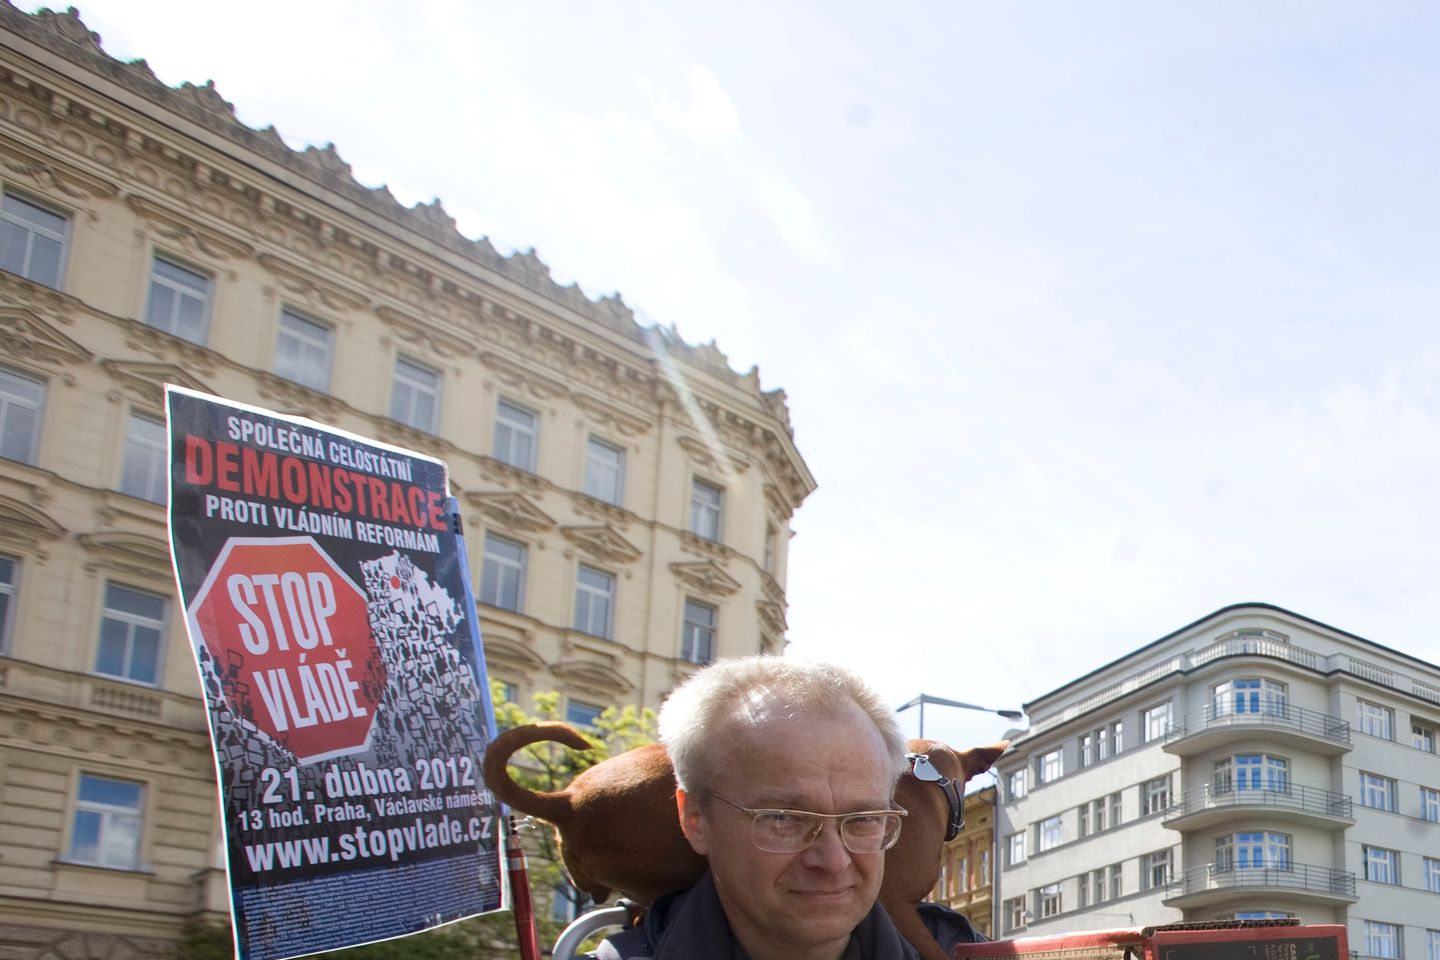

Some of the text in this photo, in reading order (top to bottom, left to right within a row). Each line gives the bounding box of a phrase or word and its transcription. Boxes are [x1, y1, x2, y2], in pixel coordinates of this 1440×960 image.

[227, 416, 412, 482] SPOLEČNÁ CELOSTÁTNÍ
[185, 435, 448, 531] DEMONSTRACE
[206, 494, 440, 554] PROTI VLÁDNÍM REFORMÁM
[227, 571, 337, 655] STOP
[252, 648, 368, 732] VLÁDĚ
[261, 756, 475, 804] 21. dubna 2012
[238, 810, 263, 831] 13
[269, 805, 310, 827] hod.
[315, 801, 371, 825] Praha,
[374, 794, 443, 817] Václavské
[245, 816, 493, 873] www.stopvlade.cz
